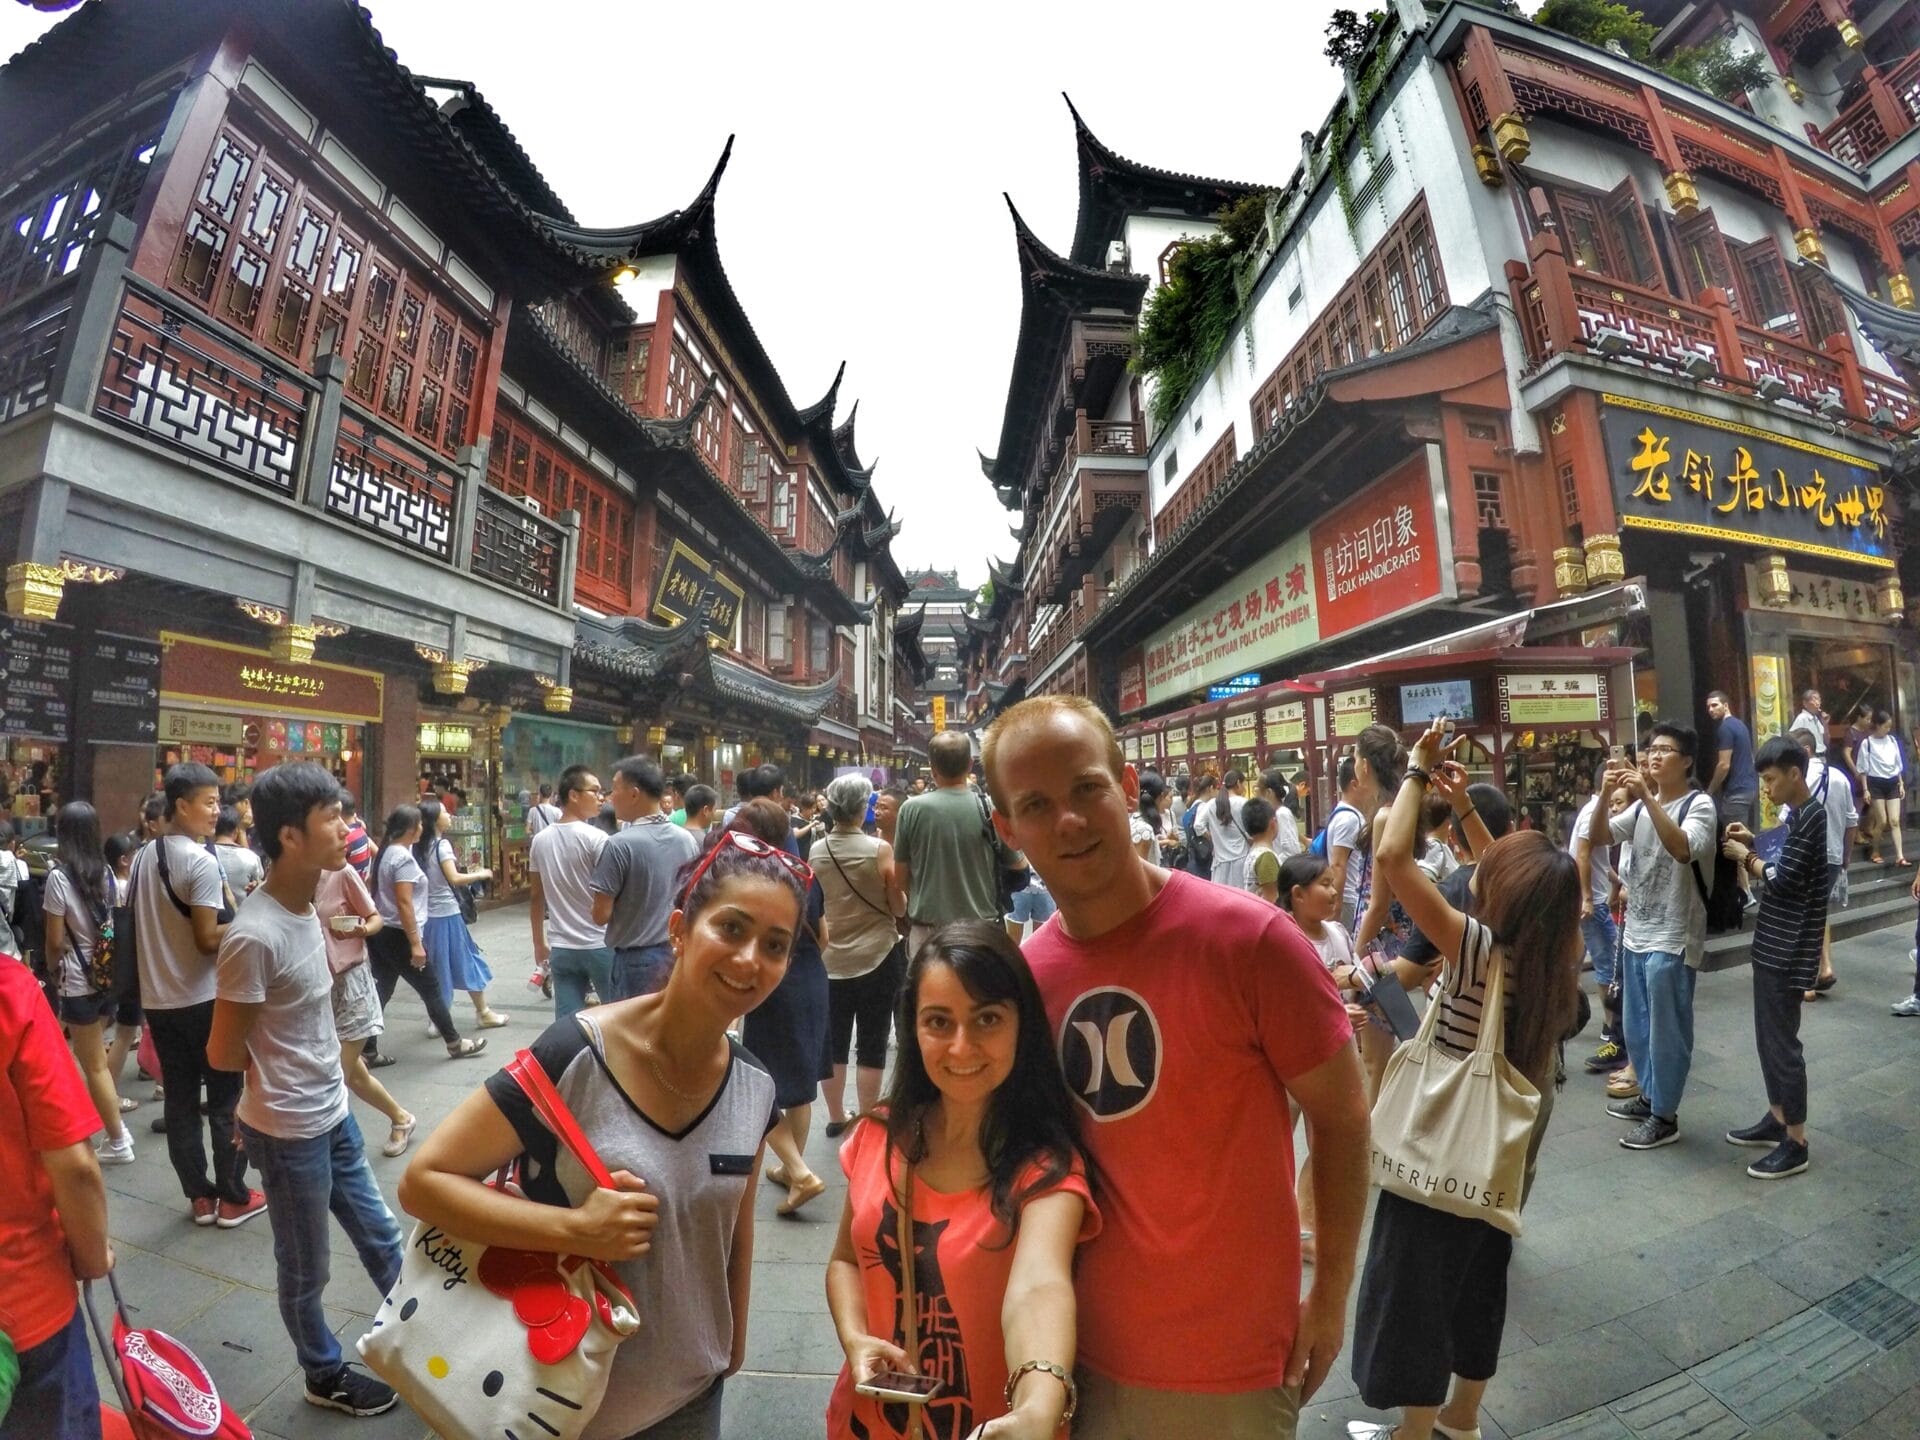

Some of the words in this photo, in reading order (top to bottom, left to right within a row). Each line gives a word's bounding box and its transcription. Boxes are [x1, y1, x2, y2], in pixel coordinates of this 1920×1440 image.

[1631, 426, 1889, 539] 老邻居小吃世界
[1336, 505, 1418, 577] 坊间印象
[1338, 576, 1358, 597] FOLK
[1358, 545, 1421, 587] HANDICRAFTS
[1239, 628, 1258, 649] FOLK
[1259, 603, 1311, 639] CRAFTSMEN
[1540, 679, 1580, 692] 草编
[415, 1226, 468, 1291] Kitty
